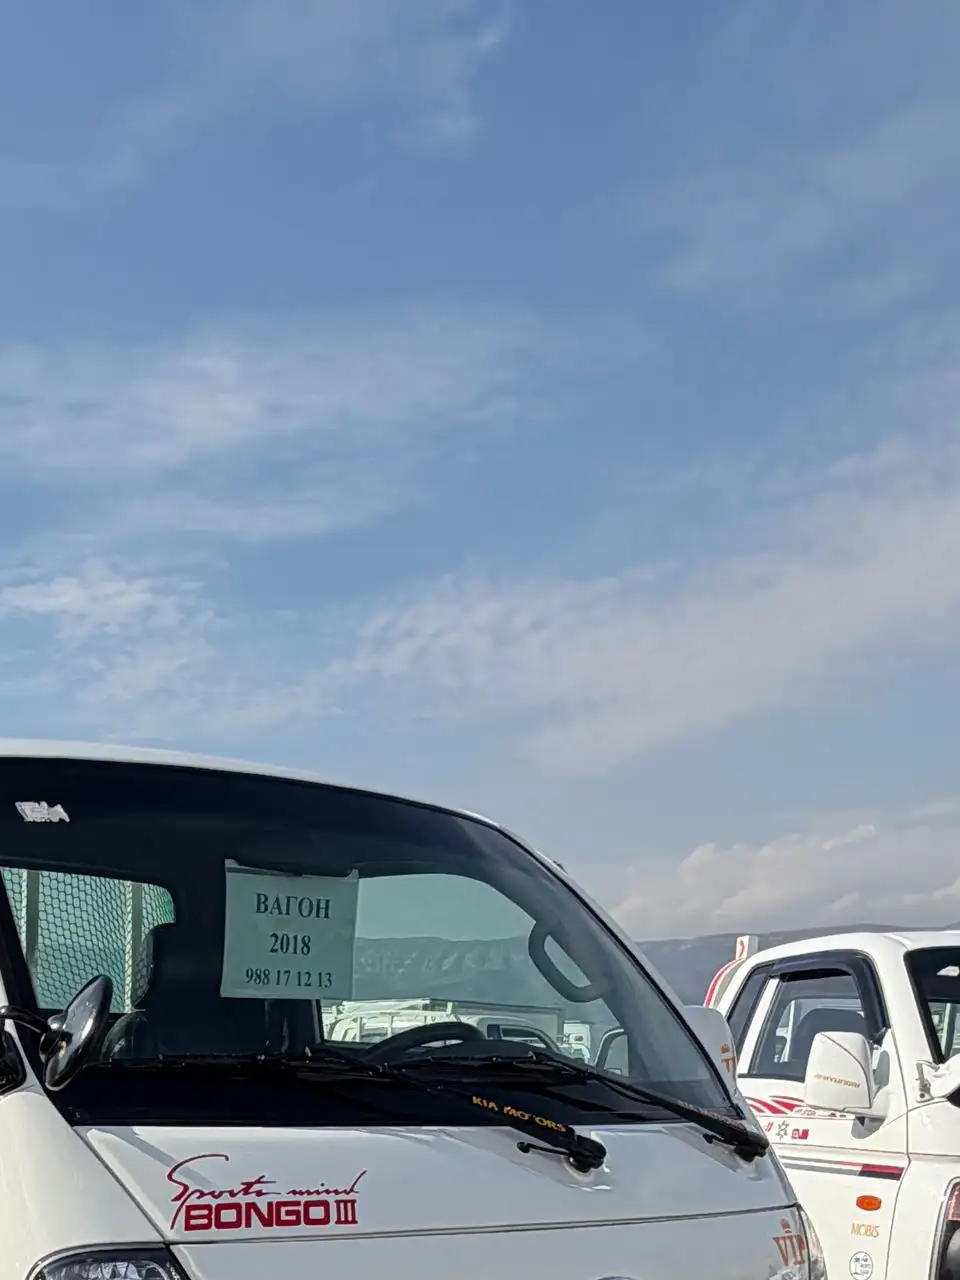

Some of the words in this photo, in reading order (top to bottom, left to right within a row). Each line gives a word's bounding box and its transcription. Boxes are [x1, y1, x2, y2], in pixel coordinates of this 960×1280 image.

[255, 892, 332, 919] ВАГОН
[269, 932, 312, 956] 2018
[245, 967, 271, 986] 988
[275, 969, 292, 987] 17
[296, 970, 312, 988] 12
[317, 971, 333, 989] 13
[471, 1095, 499, 1112] KIA
[184, 1199, 331, 1232] BONGO
[851, 1222, 880, 1238] MOBIS
